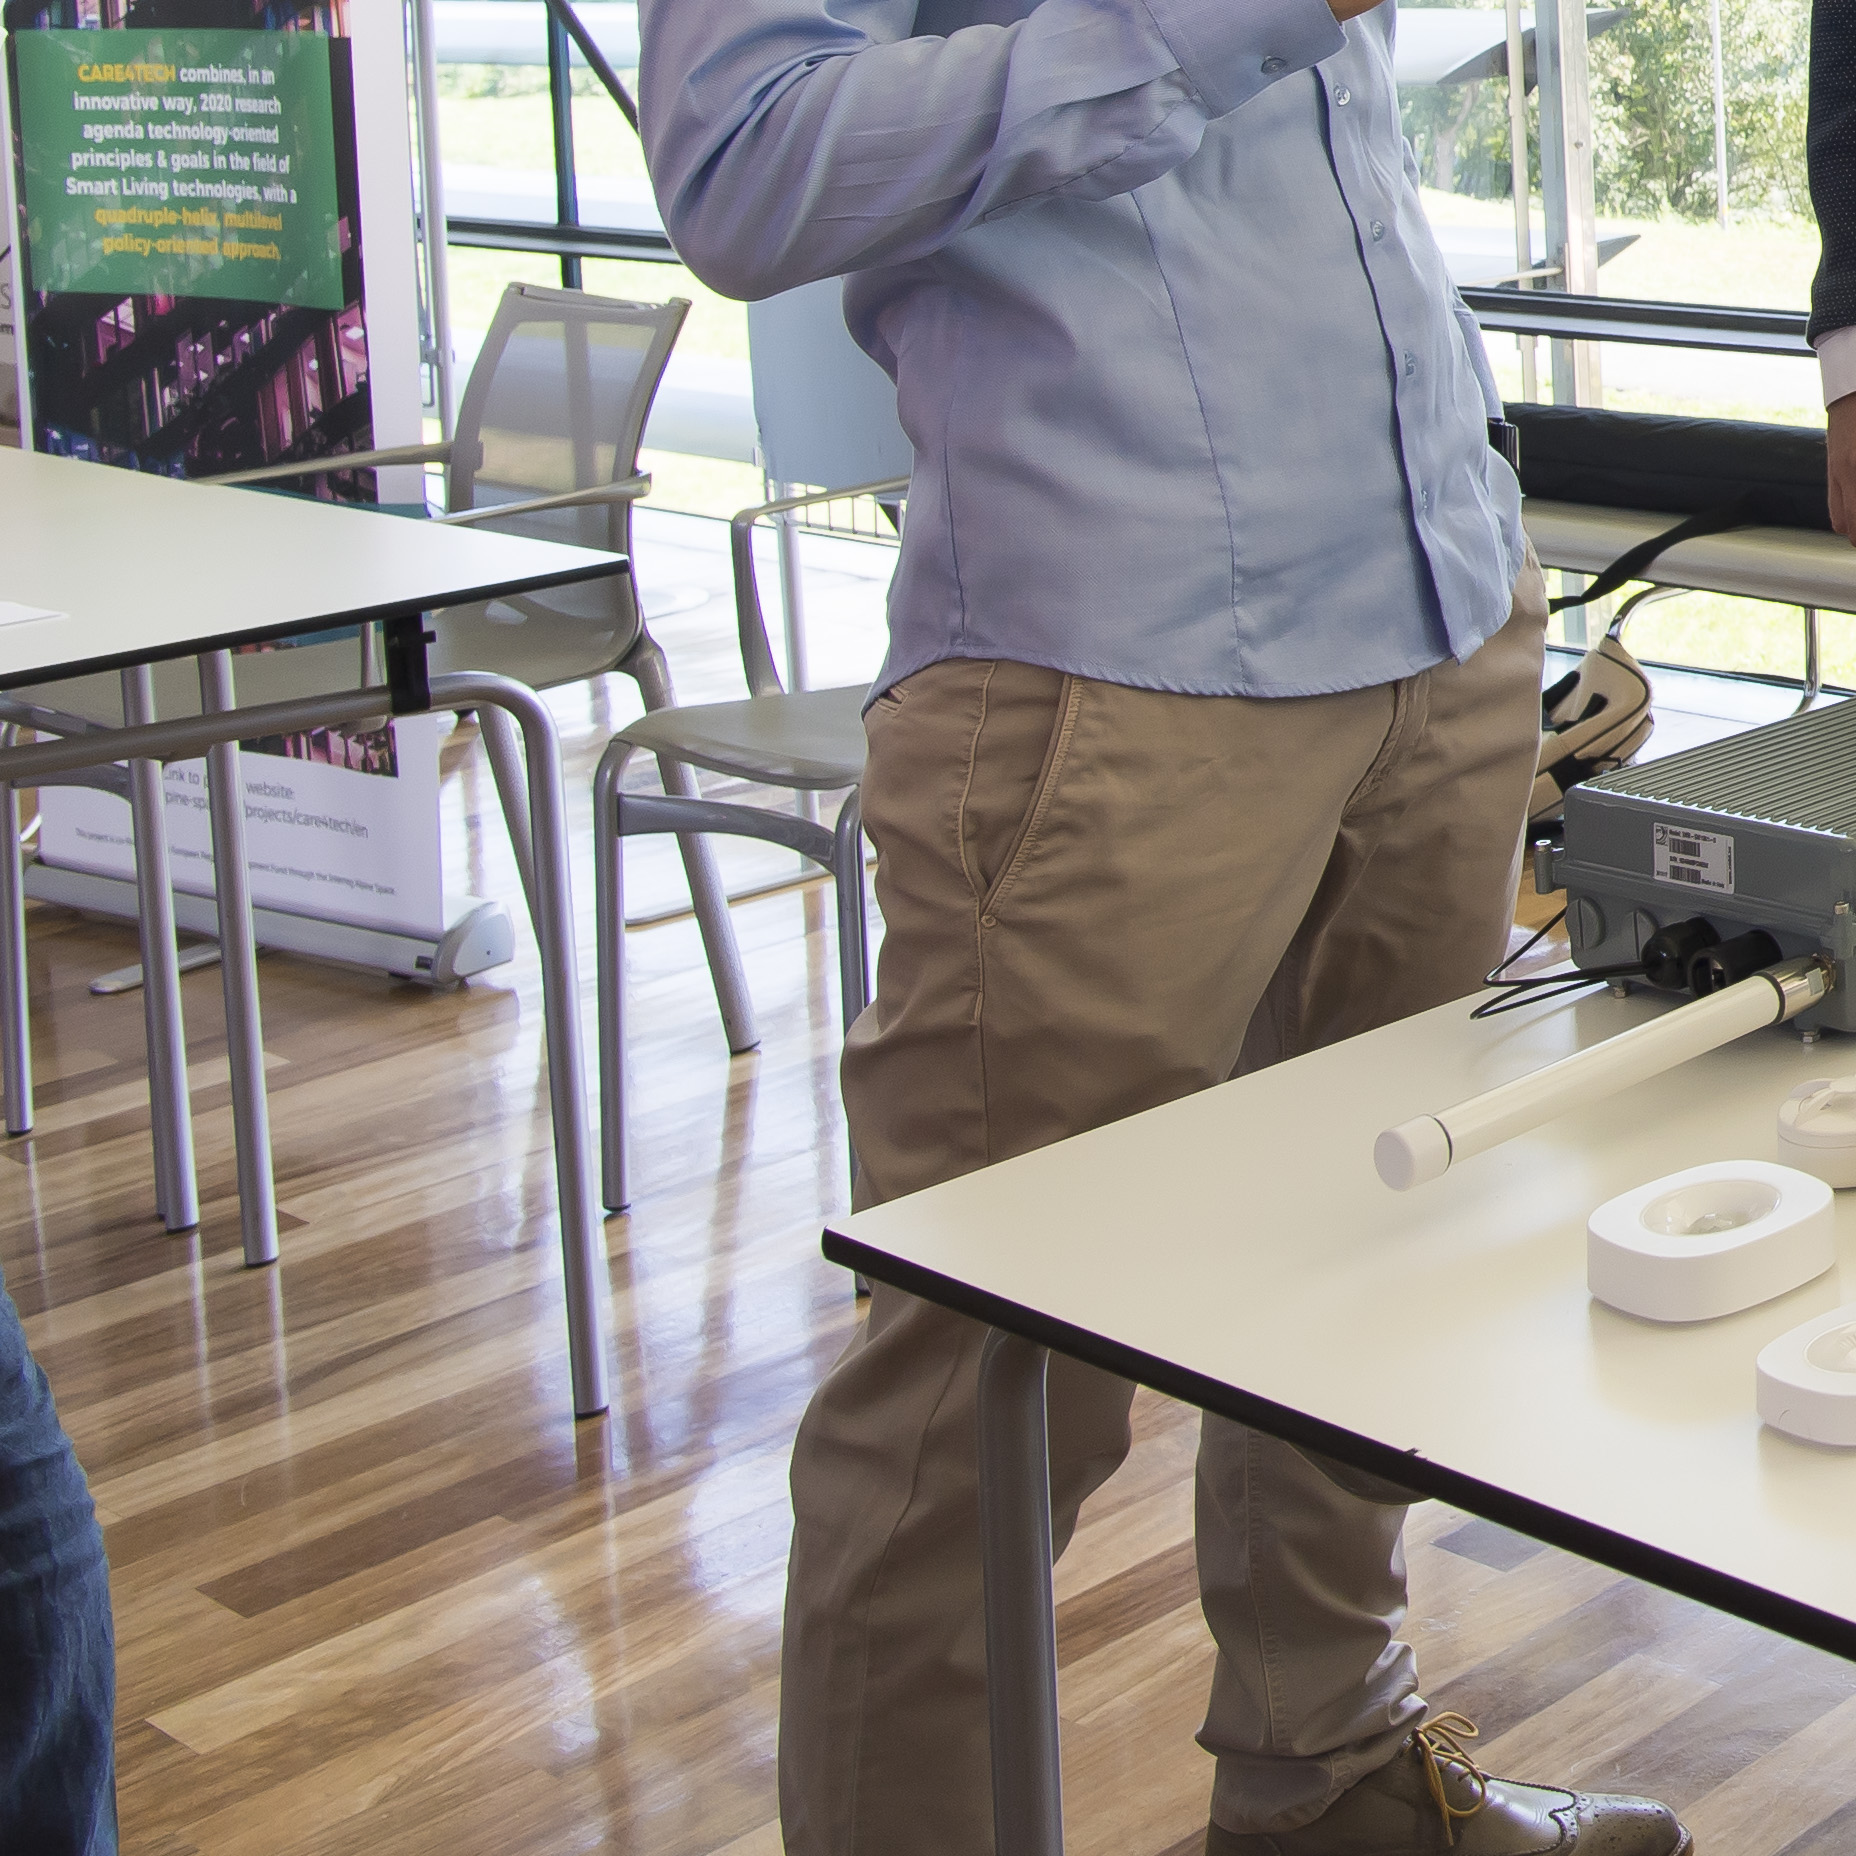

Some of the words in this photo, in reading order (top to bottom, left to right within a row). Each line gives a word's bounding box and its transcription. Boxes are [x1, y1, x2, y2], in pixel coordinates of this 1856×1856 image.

[77, 64, 176, 82] CARE4TECH
[248, 64, 259, 84] in
[162, 94, 197, 116] way,
[200, 93, 232, 112] 2020
[235, 96, 282, 115] research
[82, 120, 144, 143] agenda
[147, 121, 280, 145] technology-oriented
[70, 148, 153, 171] principles
[157, 150, 168, 168] &
[171, 150, 209, 172] goals
[213, 149, 226, 169] in
[229, 151, 250, 170] the
[252, 152, 276, 173] field
[279, 153, 291, 174] of
[65, 176, 117, 195] Smart
[122, 177, 169, 200] Living
[262, 184, 288, 202] with
[188, 769, 200, 784] to
